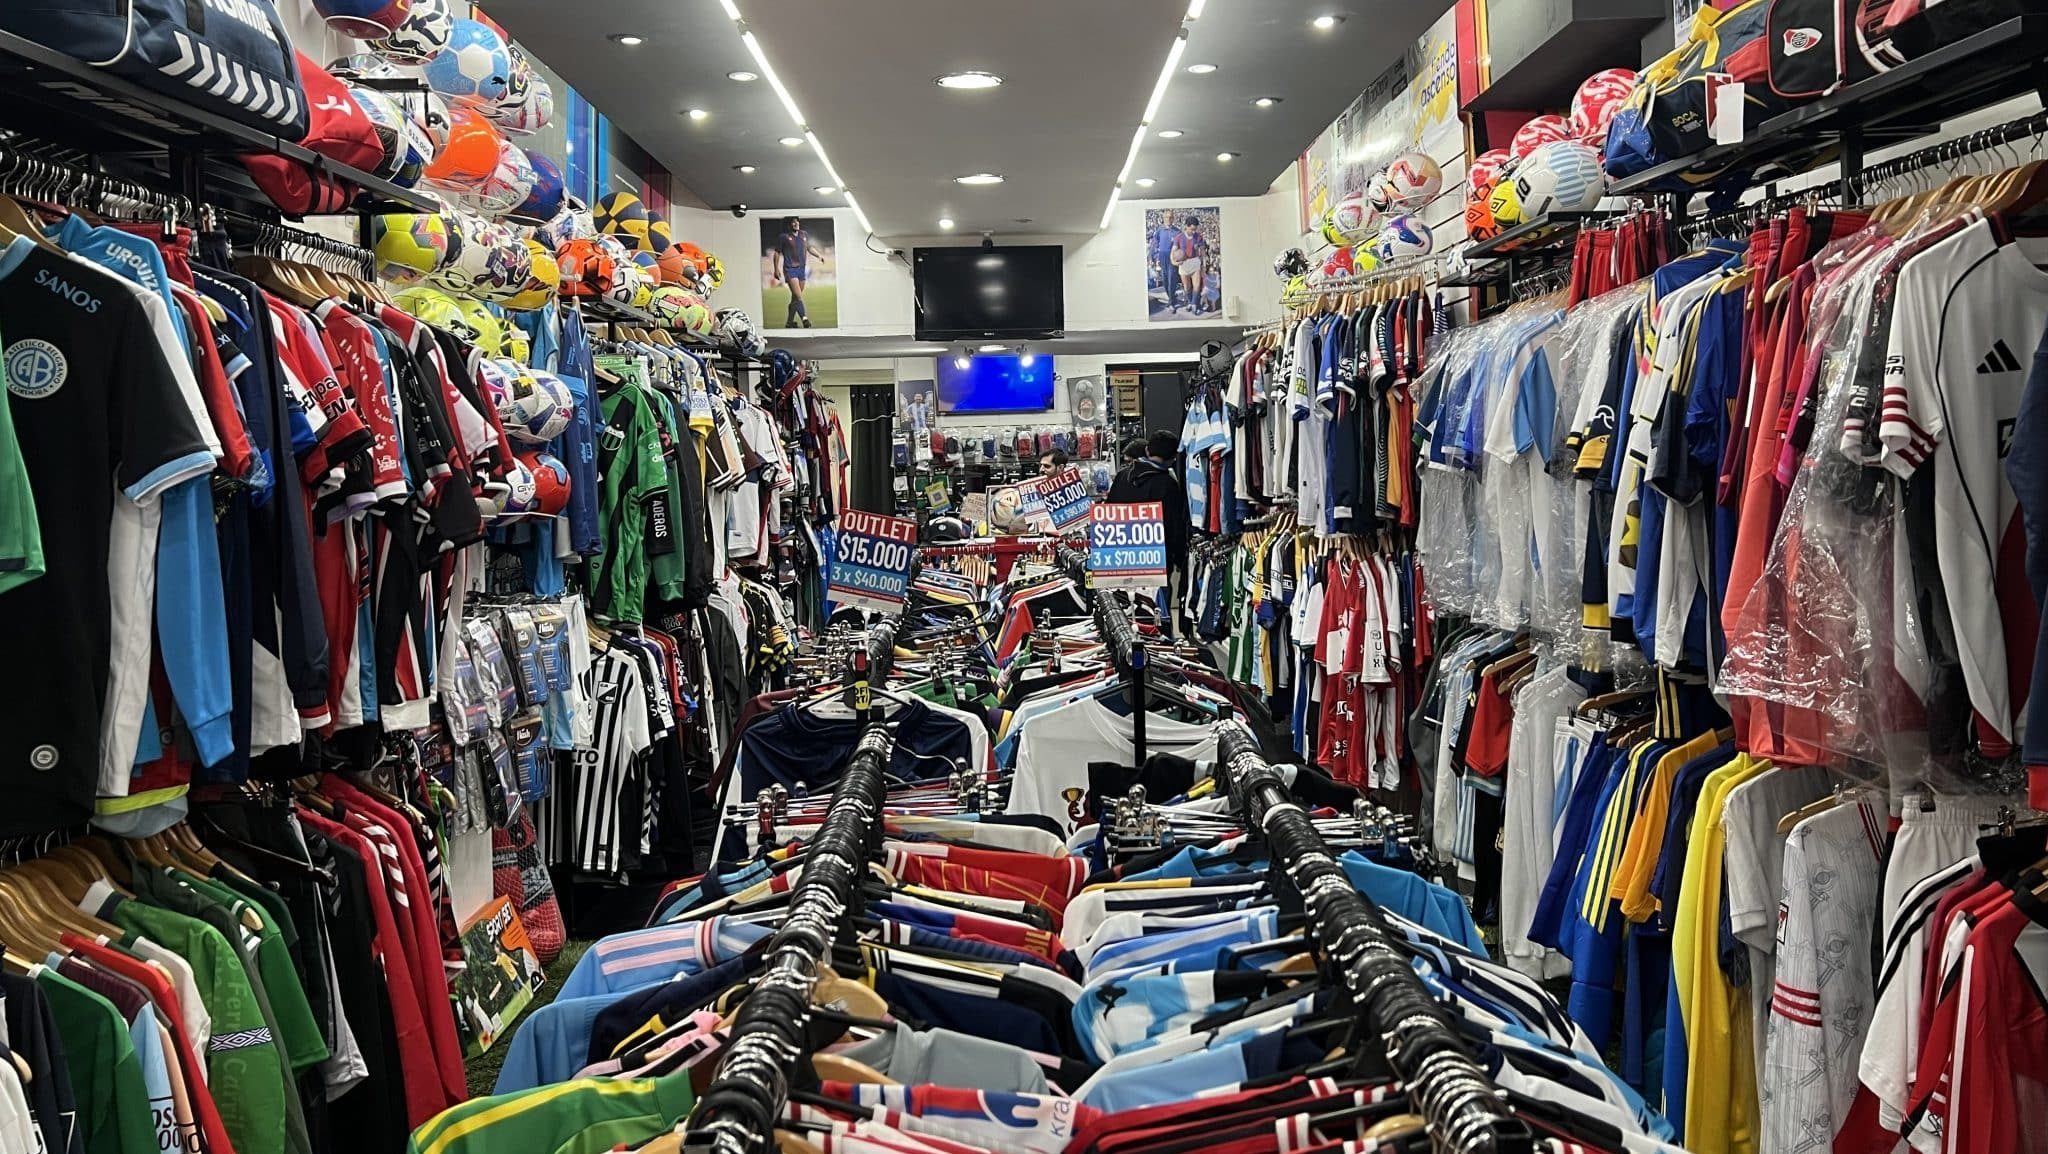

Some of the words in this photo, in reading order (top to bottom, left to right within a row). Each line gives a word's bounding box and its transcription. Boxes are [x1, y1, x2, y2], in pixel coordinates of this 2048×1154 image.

[34, 269, 102, 314] SANOS
[1040, 469, 1078, 495] OUTLET
[1043, 481, 1087, 513] $35.000
[652, 499, 668, 538] ADEROS
[843, 511, 914, 541] OUTLET
[1093, 504, 1159, 521] OUTLET
[1094, 522, 1165, 548] $25.000
[838, 532, 909, 572] $15.000
[1093, 551, 1102, 567] 3
[1104, 555, 1112, 566] x
[1114, 550, 1161, 568] $70.000
[832, 566, 842, 581] 3
[843, 572, 852, 584] x
[854, 569, 902, 593] $40.000
